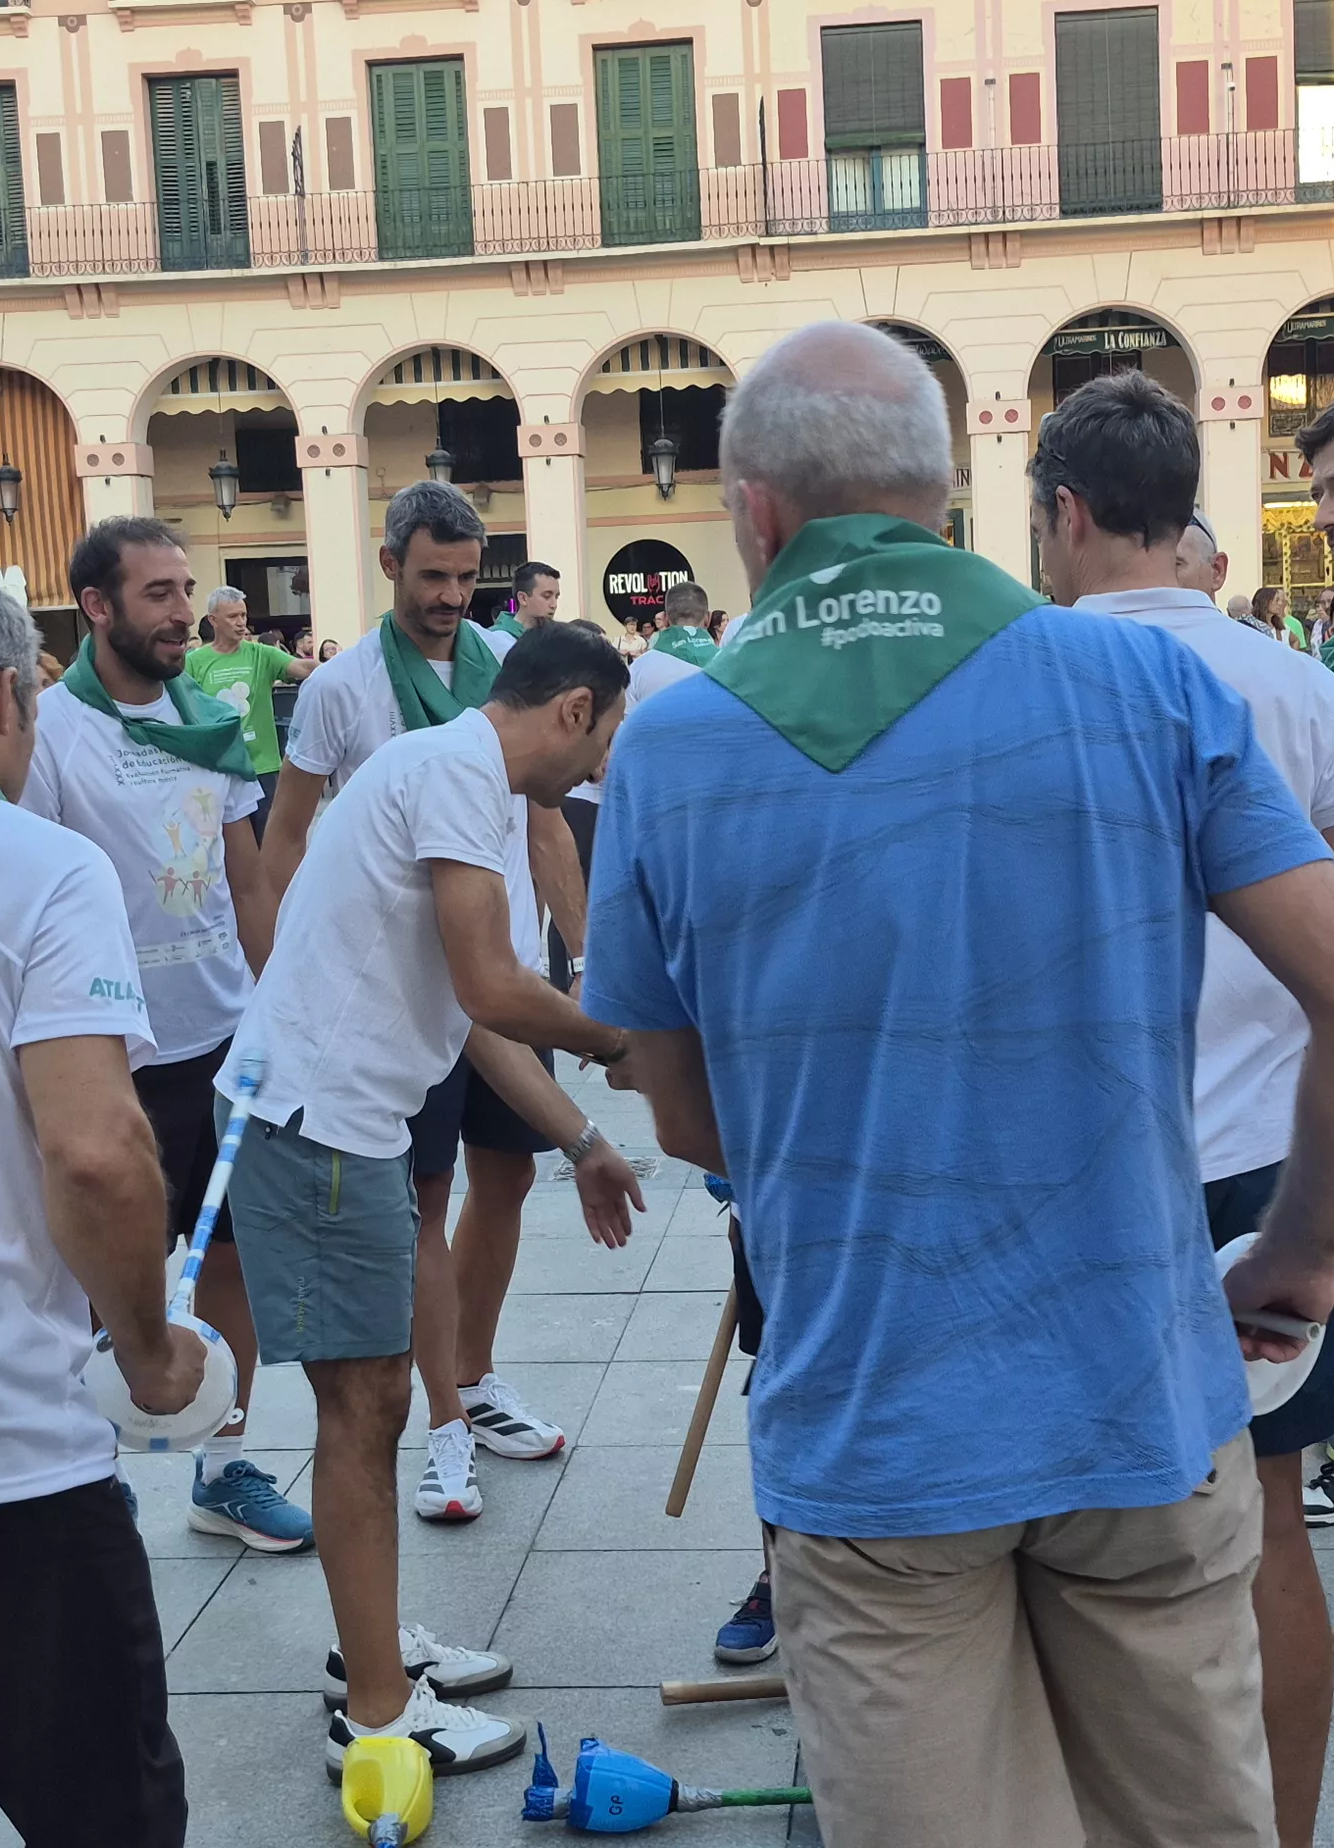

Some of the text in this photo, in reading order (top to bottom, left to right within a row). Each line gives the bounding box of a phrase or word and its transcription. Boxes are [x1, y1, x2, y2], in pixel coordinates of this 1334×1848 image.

[1118, 331, 1167, 348] CONFIANZA
[630, 595, 665, 606] TRAC
[796, 589, 942, 629] Lorenzo
